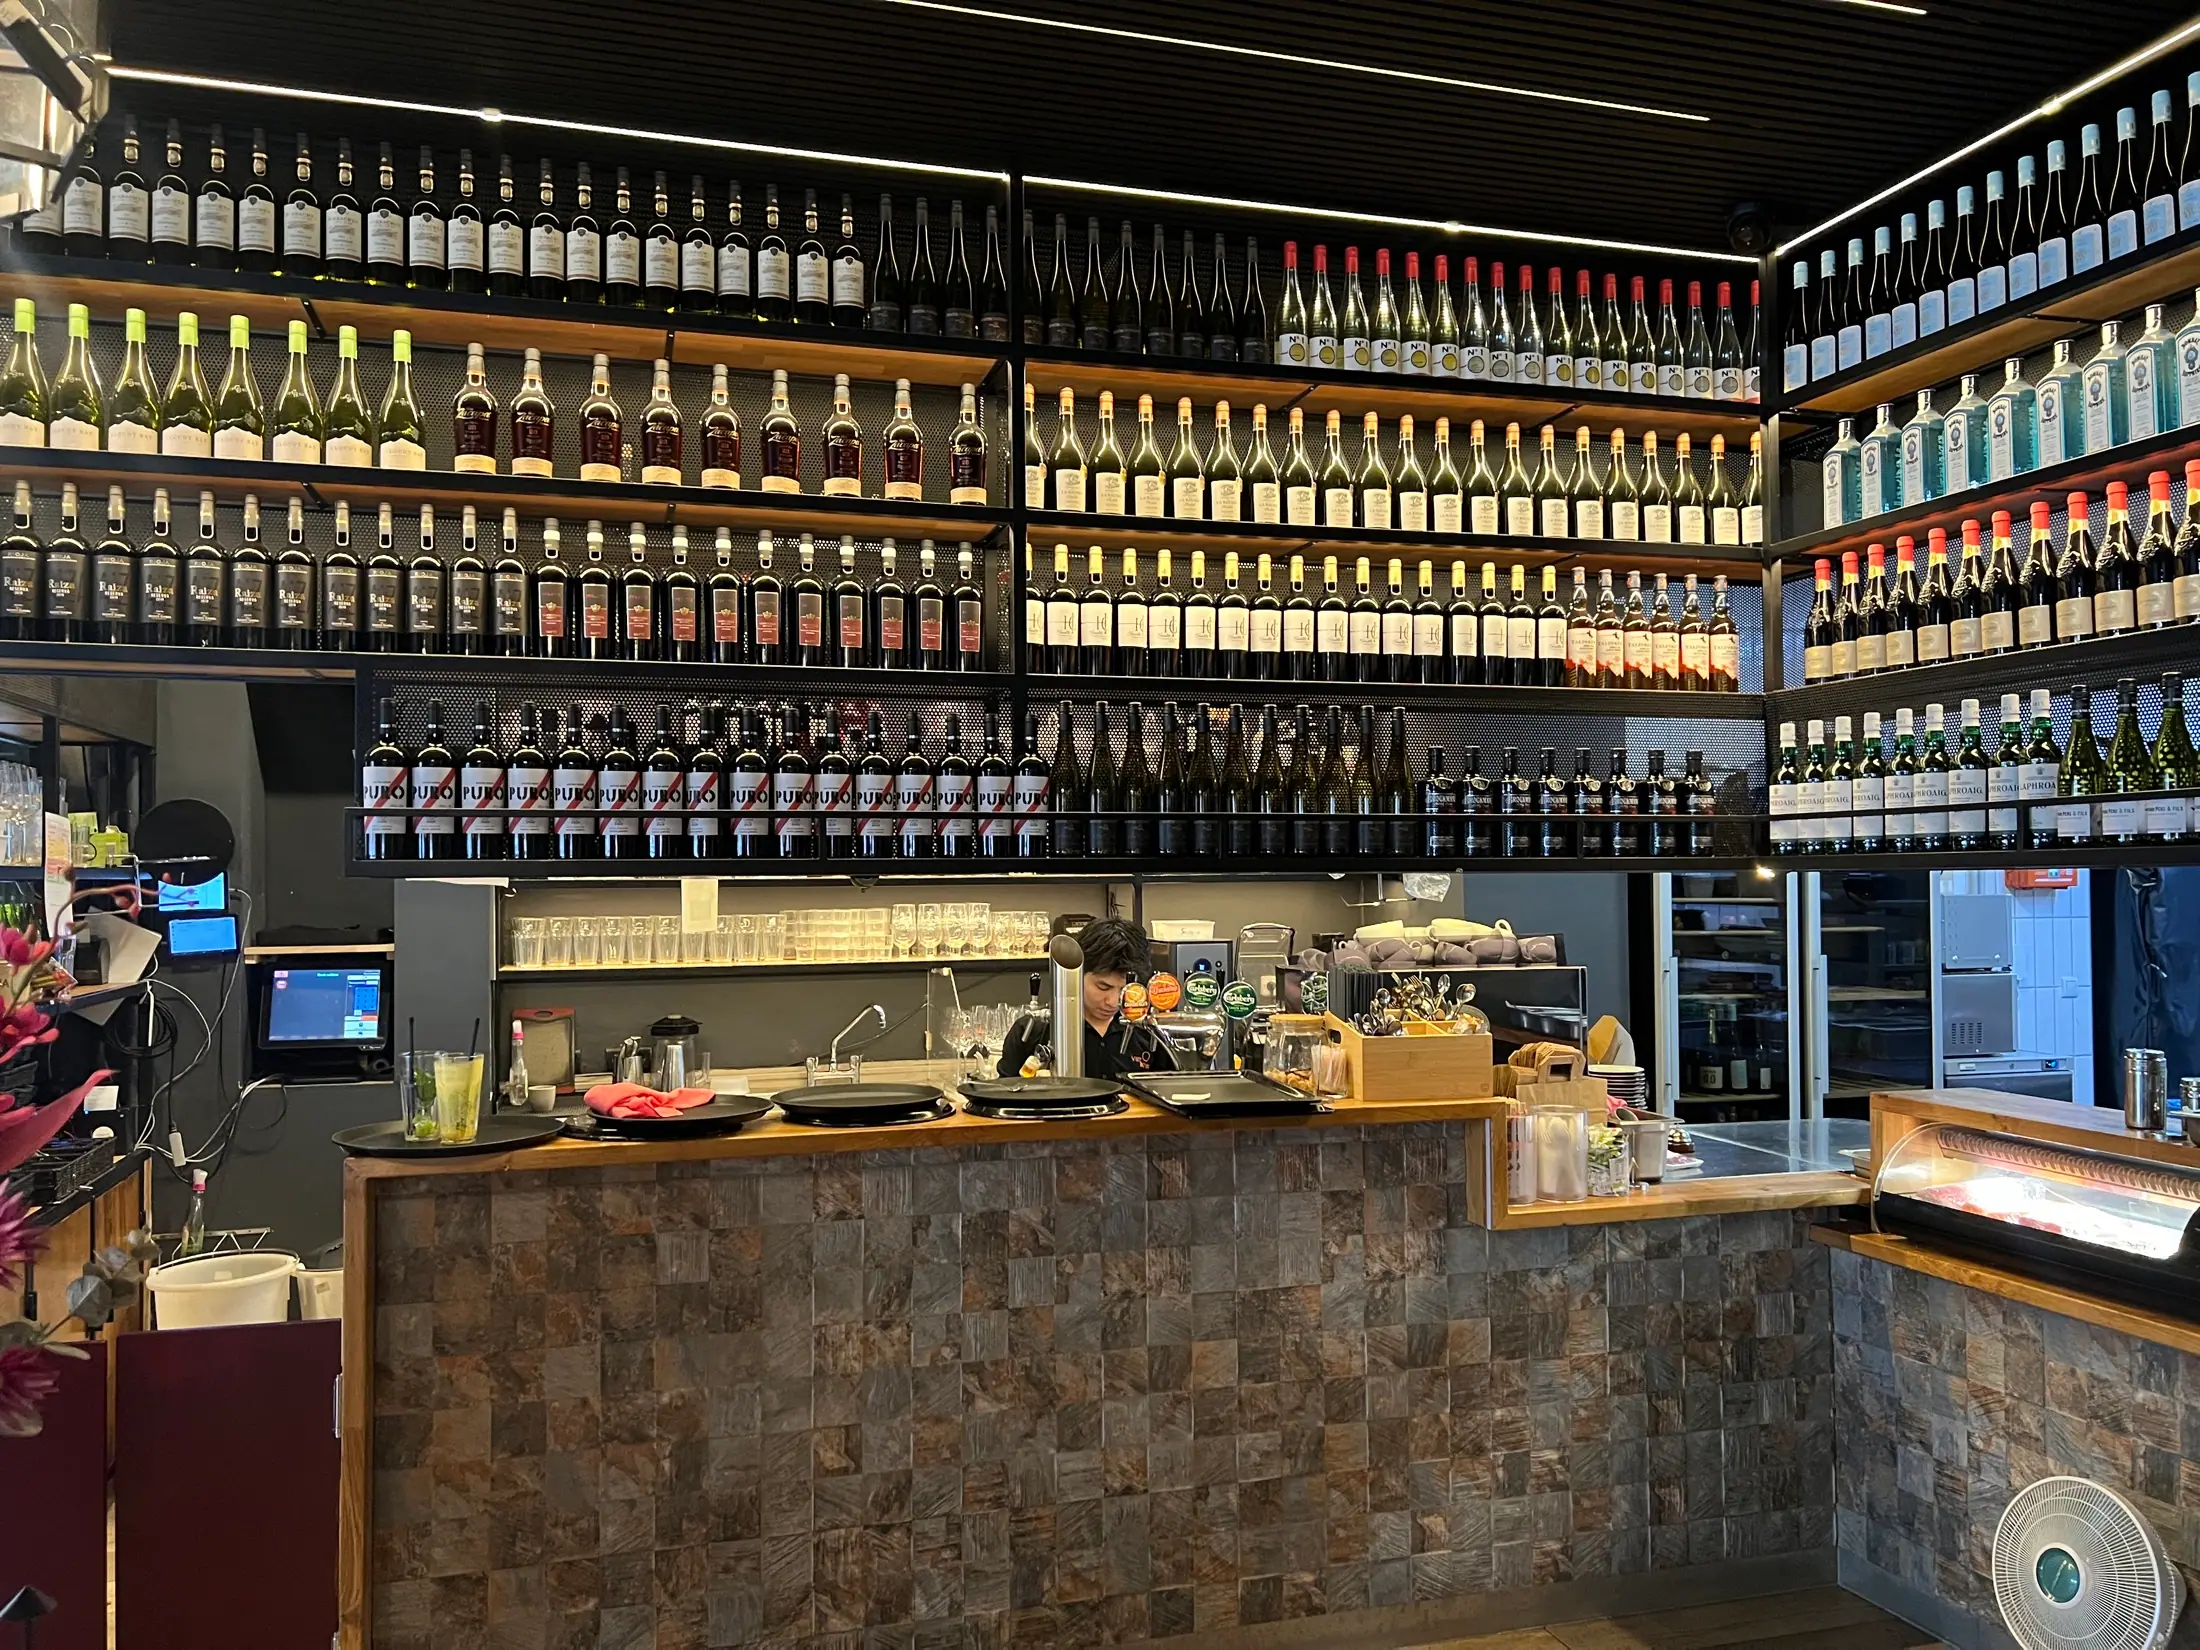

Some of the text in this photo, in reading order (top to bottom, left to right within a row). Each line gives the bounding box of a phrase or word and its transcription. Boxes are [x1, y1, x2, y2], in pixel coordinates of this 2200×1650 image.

[455, 408, 491, 421] Zacapa
[516, 412, 550, 426] Zacapa
[586, 417, 619, 432] Zacapa
[4, 576, 33, 588] Raiza
[48, 579, 75, 588] Raiza
[99, 581, 128, 592] Raiza
[146, 584, 174, 594] Raiza
[190, 585, 218, 596] Raiza
[235, 588, 261, 598] Raiza
[280, 590, 306, 600] Raiza
[328, 592, 355, 602] Raiza
[370, 594, 395, 604] Raiza
[411, 595, 436, 605] Raiza
[454, 596, 479, 606] Raiza
[497, 598, 521, 608] Raiza
[364, 786, 404, 799] PURO
[413, 786, 453, 800] PURO
[463, 786, 504, 800] PURO
[509, 786, 549, 800] PURO
[555, 787, 594, 801] PURO
[600, 788, 638, 802] PURO
[643, 788, 680, 803] PURO
[686, 790, 716, 803] URO
[730, 790, 768, 804] PURO
[776, 790, 812, 804] PURO
[814, 792, 850, 804] PURO
[857, 792, 893, 805] PURO
[897, 792, 931, 805] PURO
[938, 792, 972, 805] PURO
[1016, 792, 1048, 805] PURO
[980, 793, 1012, 806] PURO
[1187, 982, 1217, 996] Carlsberg
[1223, 992, 1255, 1005] Carlsberg
